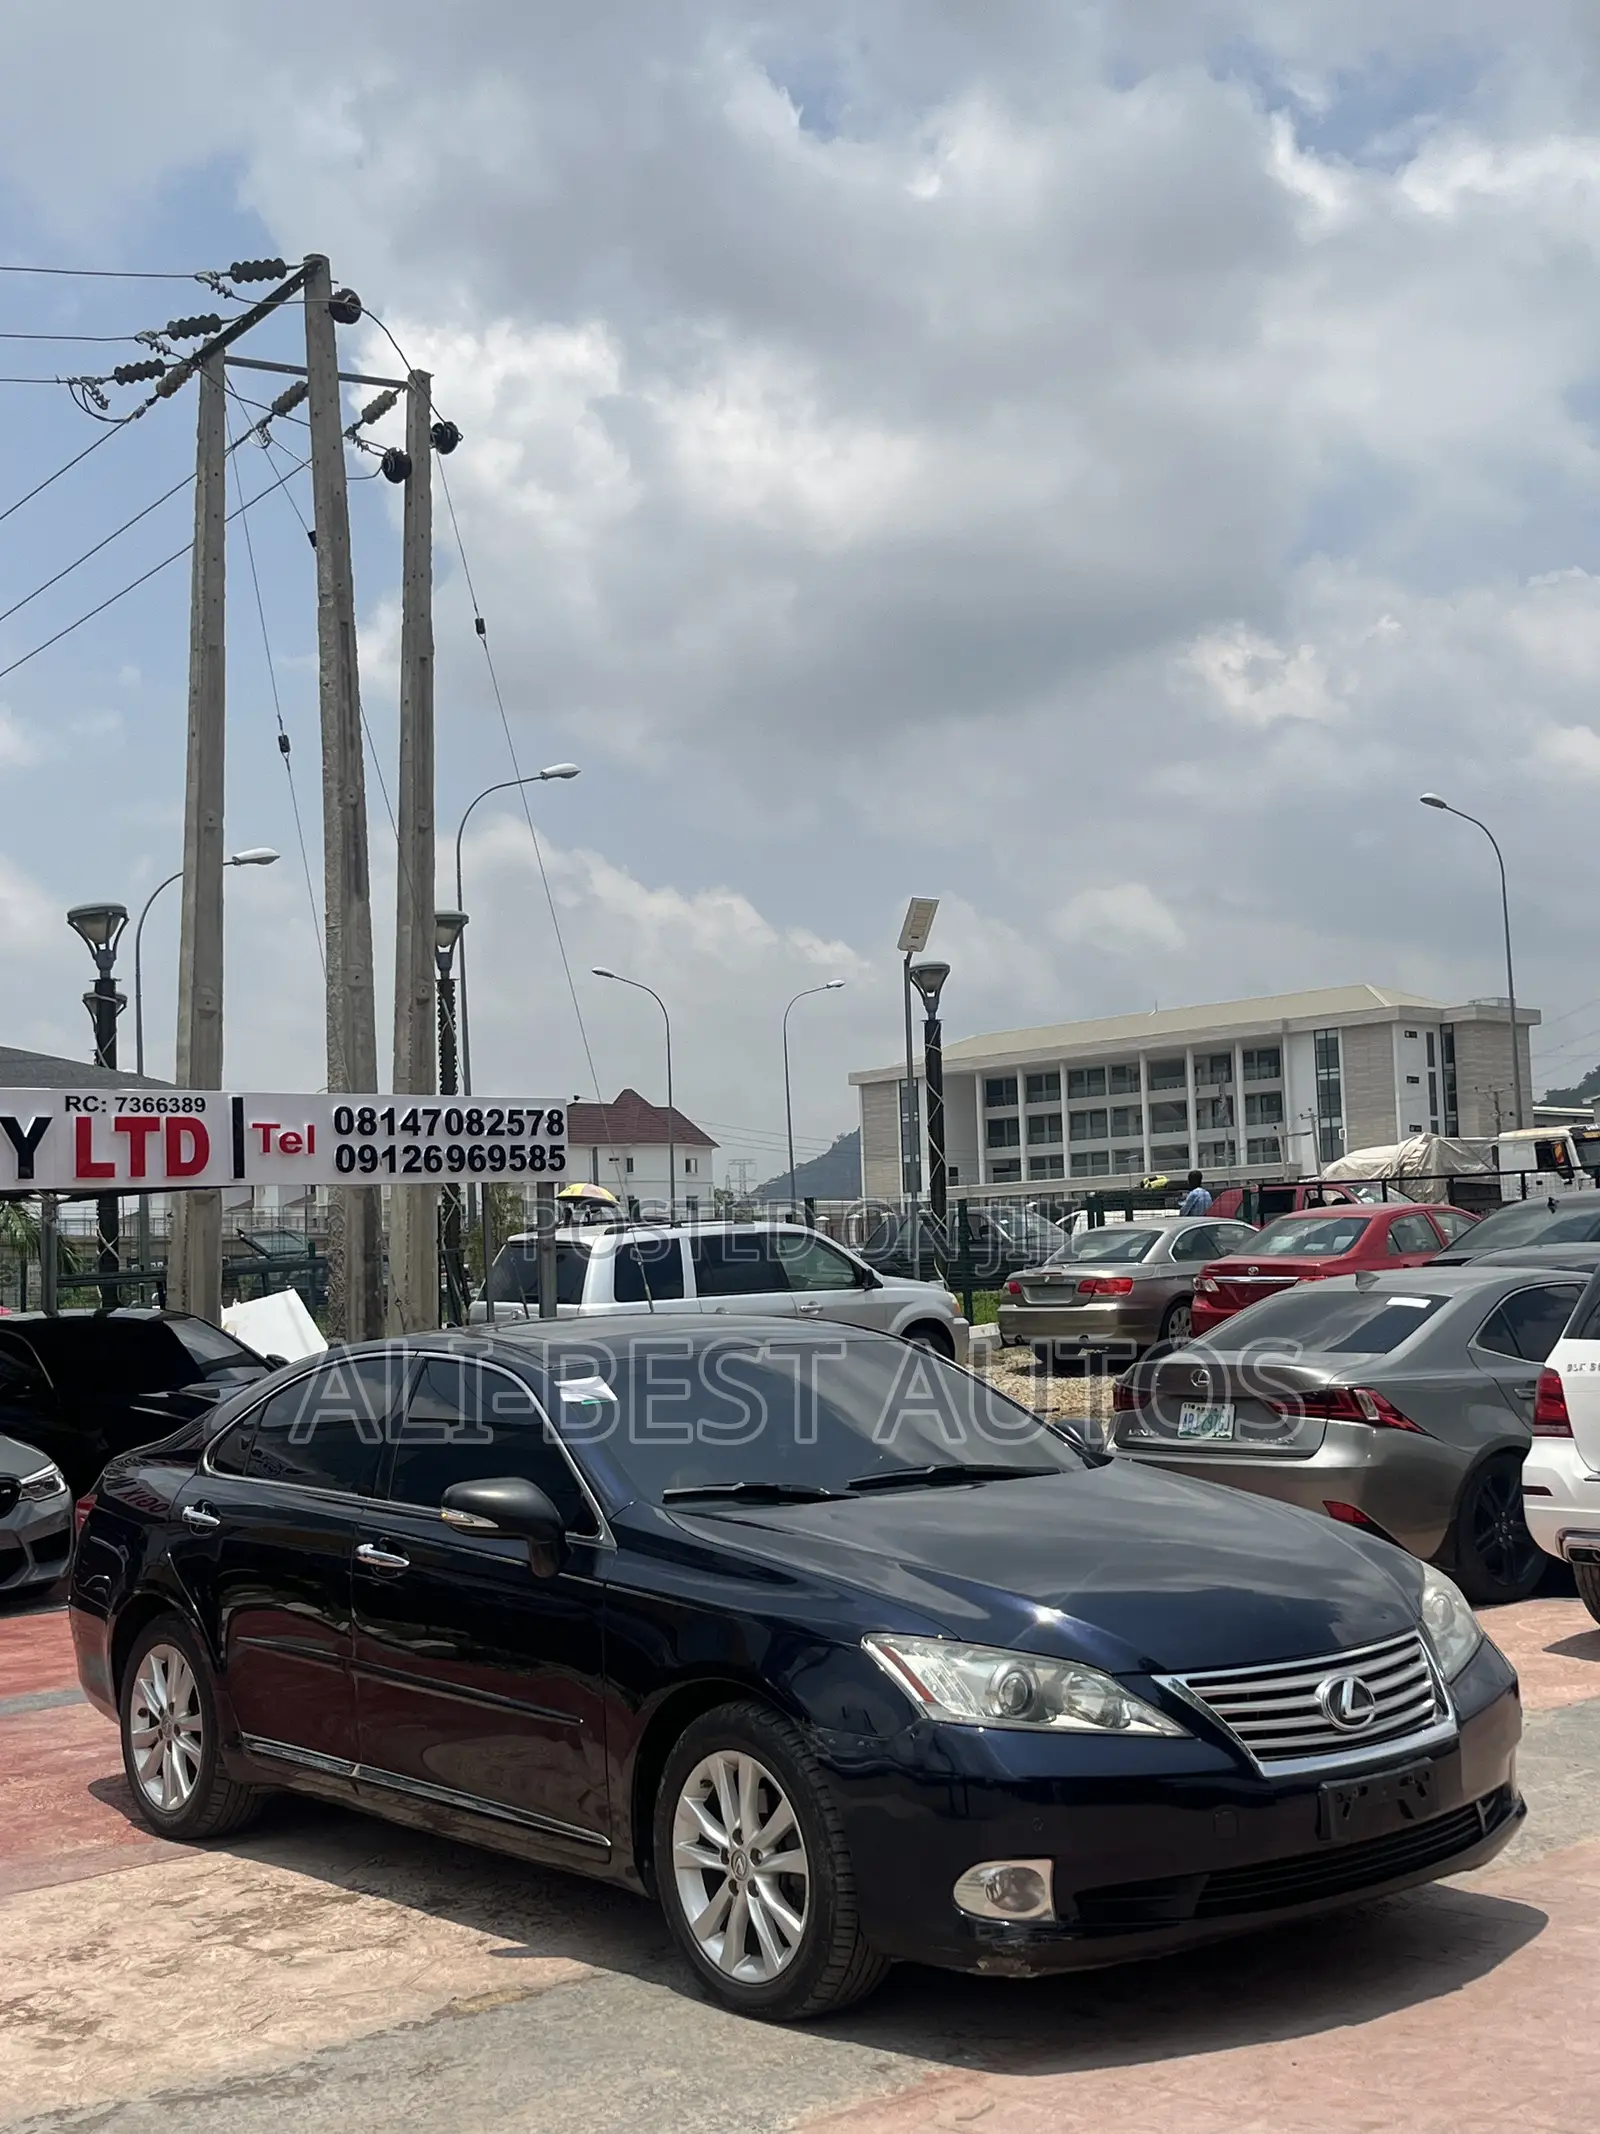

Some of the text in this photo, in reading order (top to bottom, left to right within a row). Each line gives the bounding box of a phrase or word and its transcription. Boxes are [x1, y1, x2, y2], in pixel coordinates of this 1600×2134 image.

[65, 1095, 206, 1113] RC: 7366389
[333, 1105, 565, 1138] 08147082578
[75, 1116, 211, 1179] LTD
[251, 1122, 316, 1156] Tel
[335, 1143, 567, 1174] 09126969585
